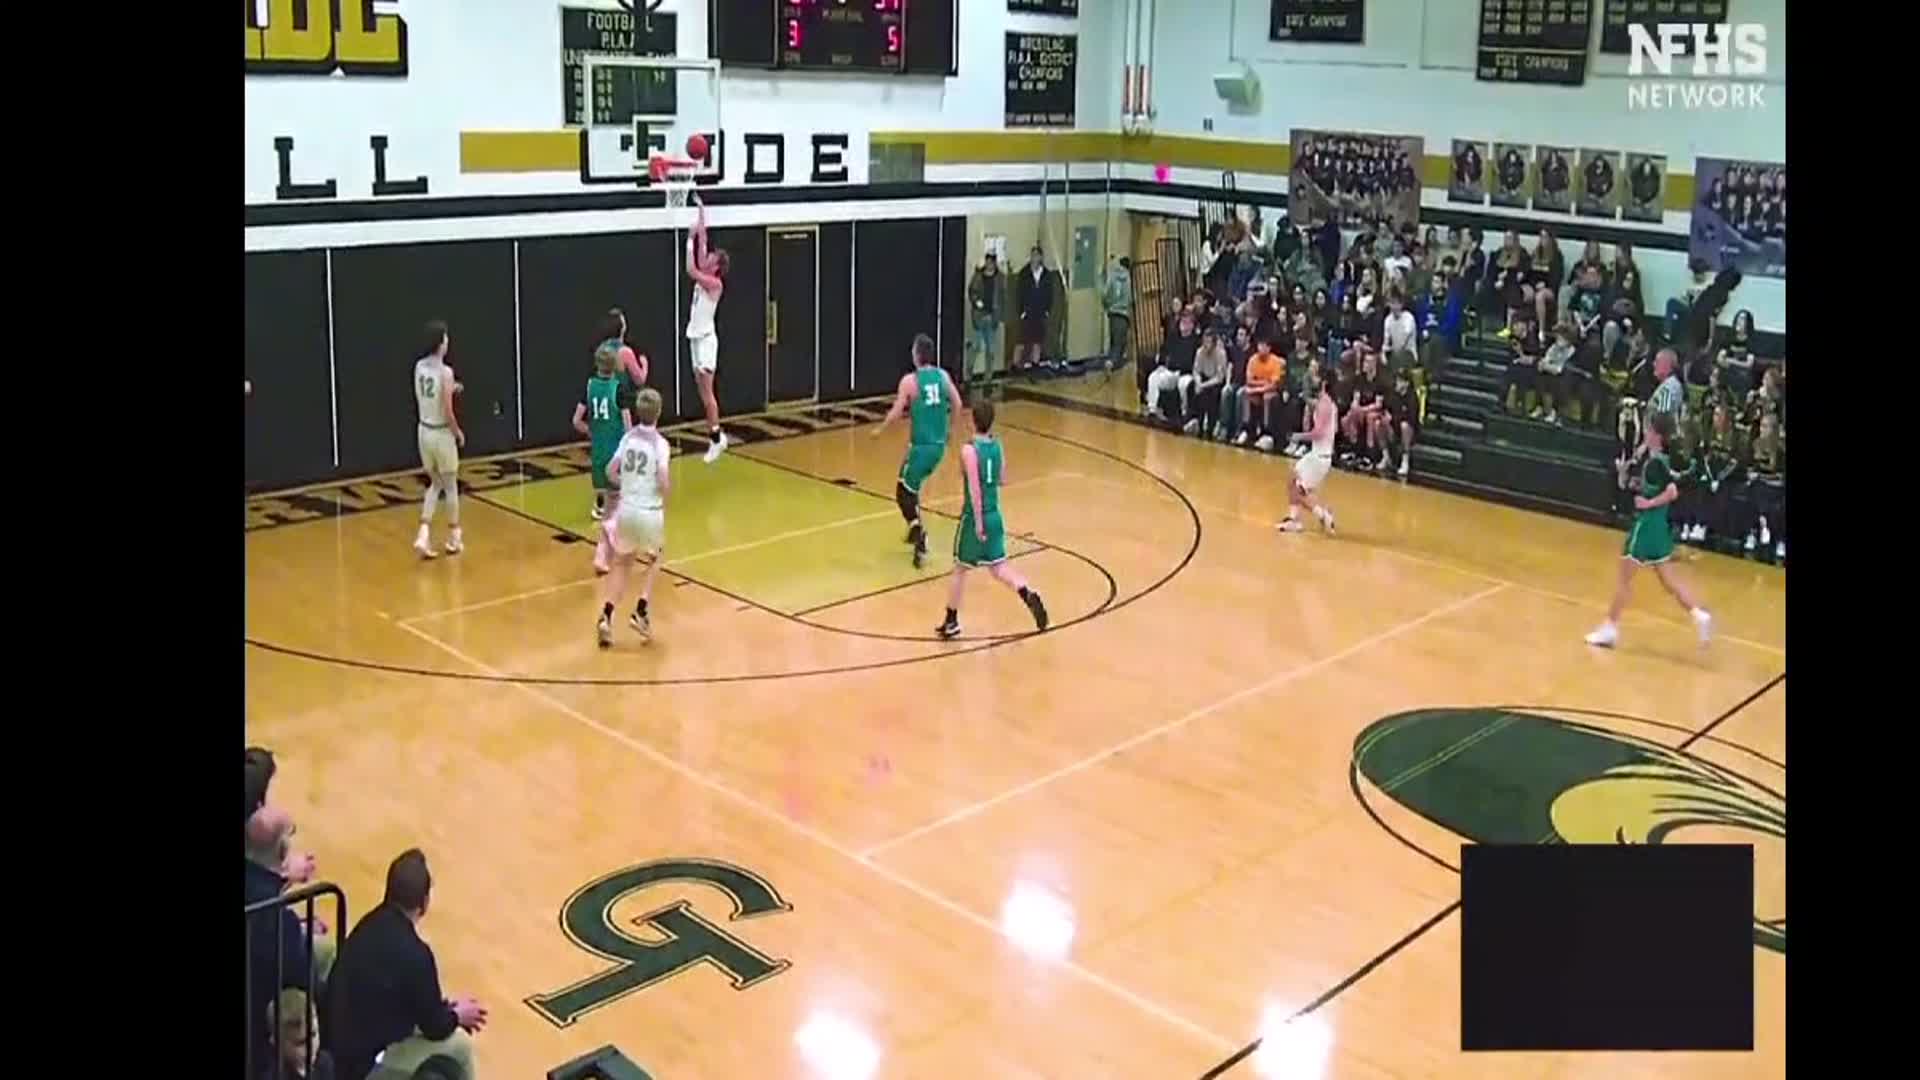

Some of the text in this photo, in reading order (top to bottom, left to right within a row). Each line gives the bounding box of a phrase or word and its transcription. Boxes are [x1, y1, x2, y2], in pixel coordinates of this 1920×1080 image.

[586, 12, 654, 32] FOOTBL
[788, 19, 800, 47] 3
[887, 25, 899, 52] 5
[420, 376, 436, 399] 12
[924, 383, 941, 405] 31
[592, 397, 610, 420] 14
[624, 449, 647, 476] 32
[986, 458, 993, 484] 1
